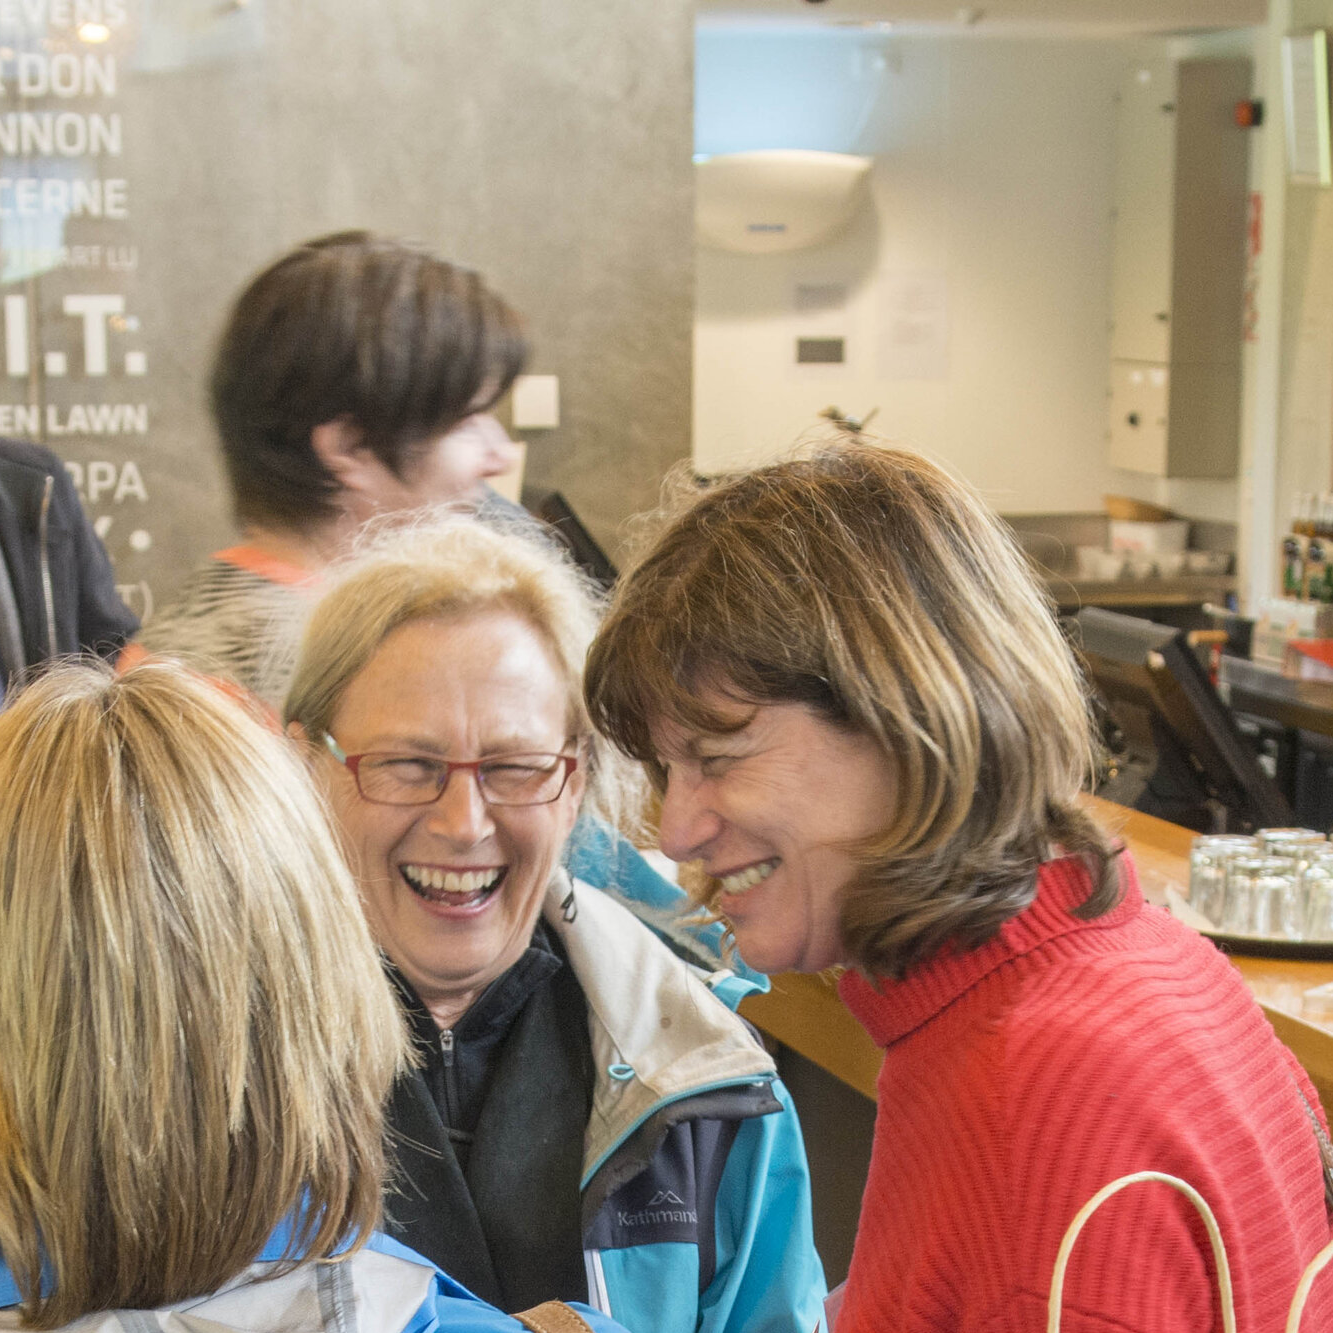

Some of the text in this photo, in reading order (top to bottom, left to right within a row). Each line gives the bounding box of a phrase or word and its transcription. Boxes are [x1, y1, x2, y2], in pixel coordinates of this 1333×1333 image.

[18, 52, 117, 99] DON
[4, 293, 148, 377] I.T.
[45, 403, 149, 436] LAWN
[617, 1209, 699, 1227] Kathmand
